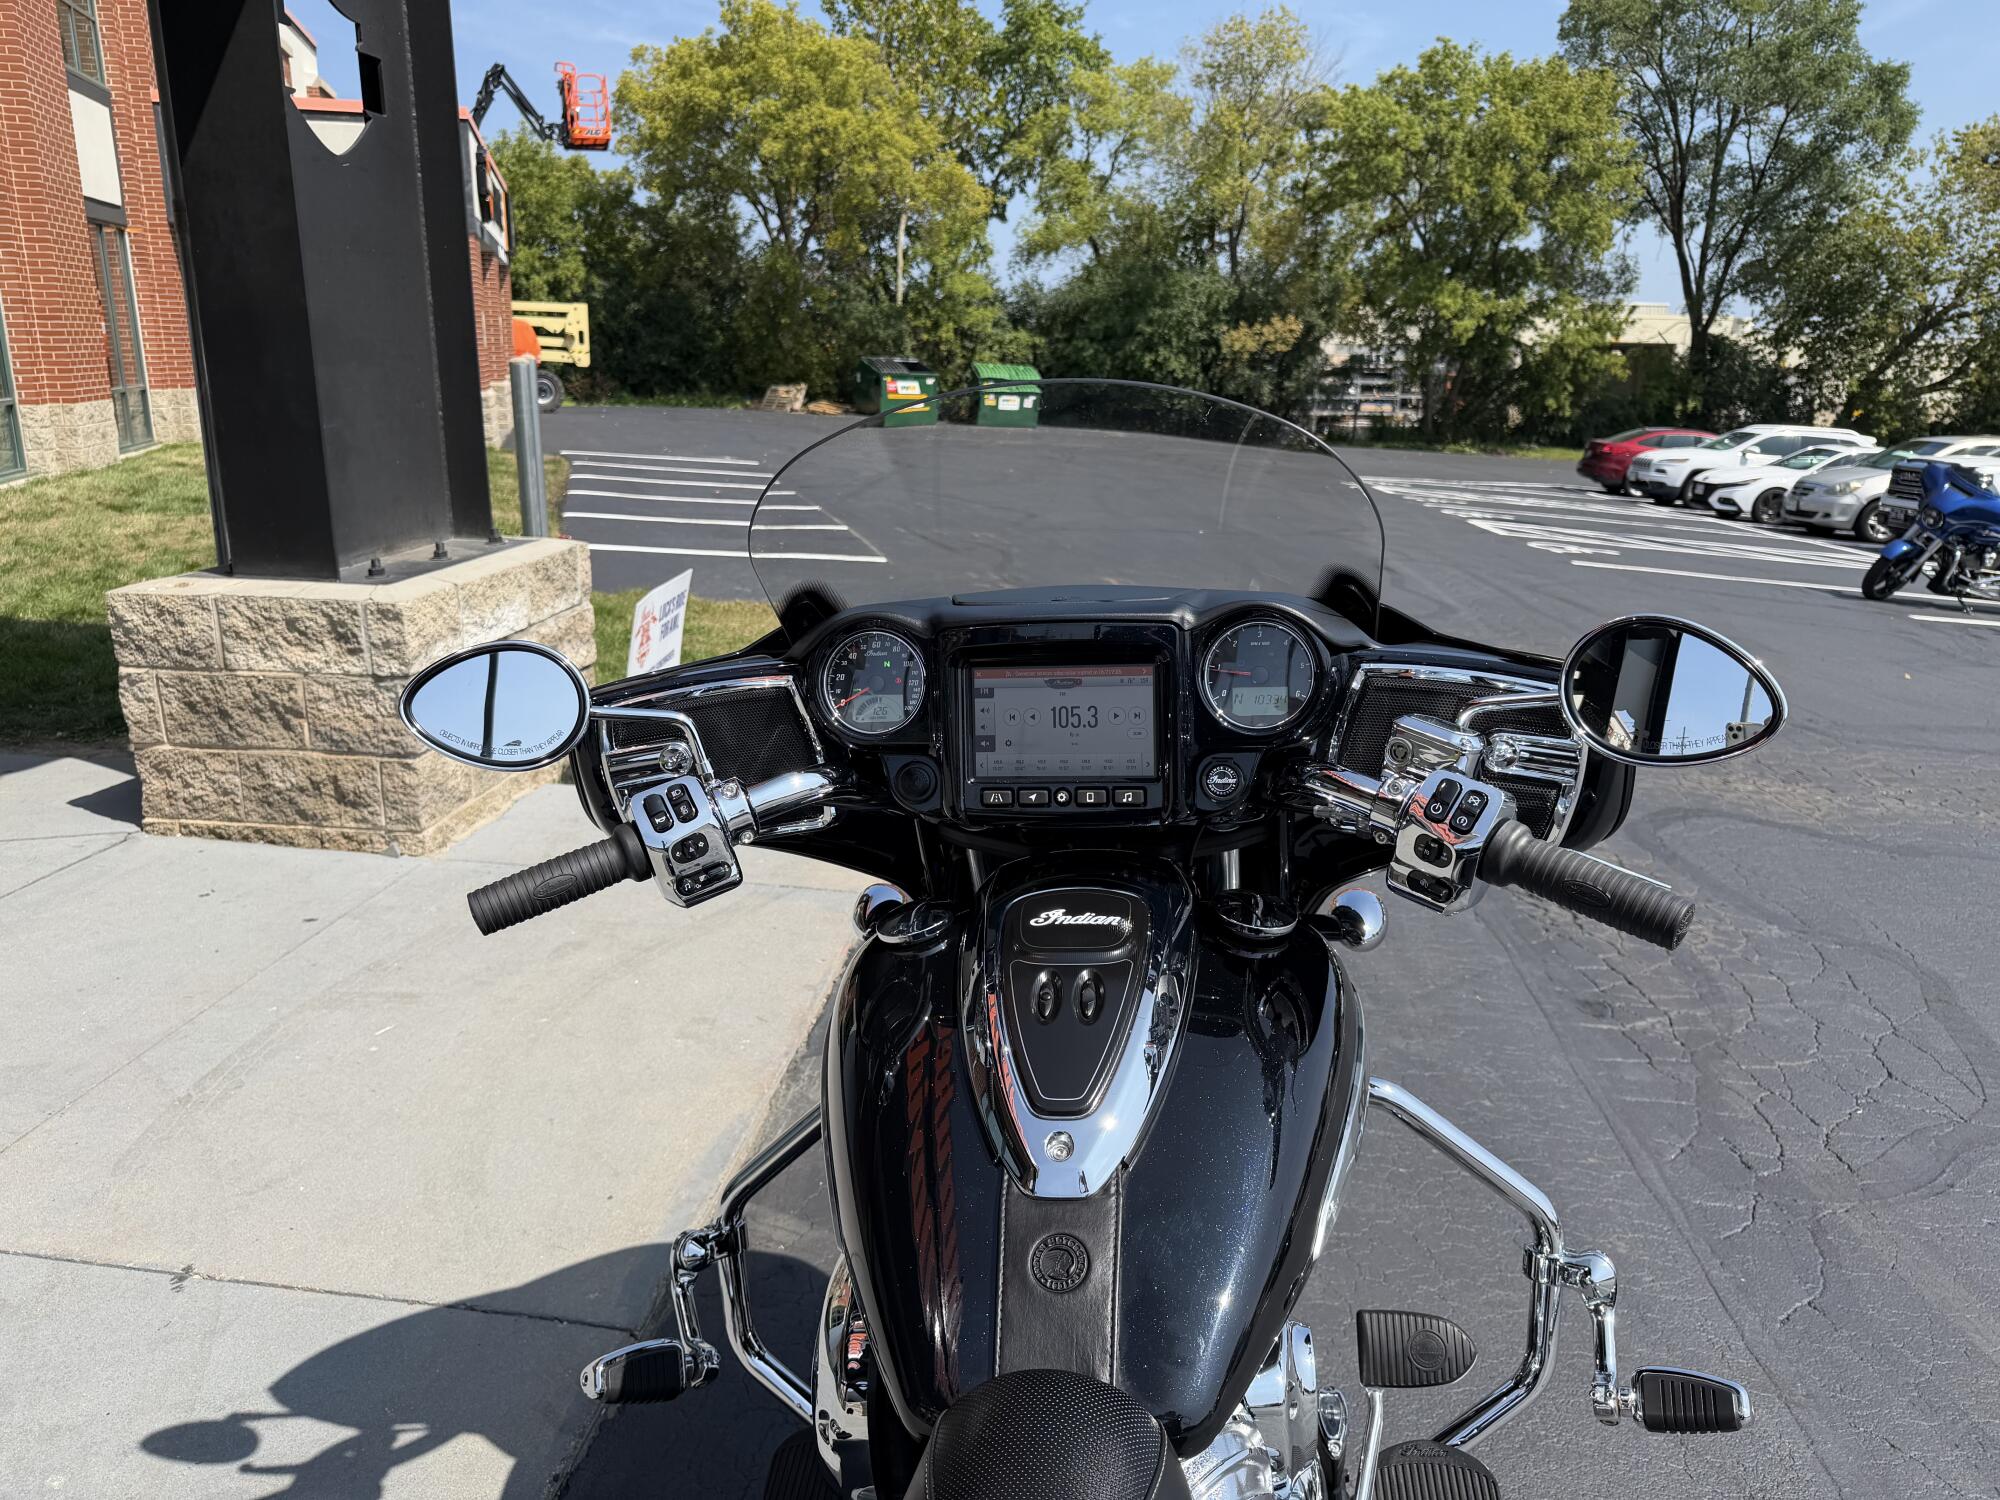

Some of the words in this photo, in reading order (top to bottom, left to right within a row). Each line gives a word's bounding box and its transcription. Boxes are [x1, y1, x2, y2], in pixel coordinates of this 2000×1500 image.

[871, 641, 881, 649] 60
[848, 652, 857, 660] 40
[836, 673, 845, 681] 20
[1050, 705, 1098, 729] 105.3
[439, 729, 461, 744] OBJECTS
[498, 747, 519, 756] CLOSER
[546, 729, 565, 746] APPEAR
[1029, 908, 1124, 927] Indian
